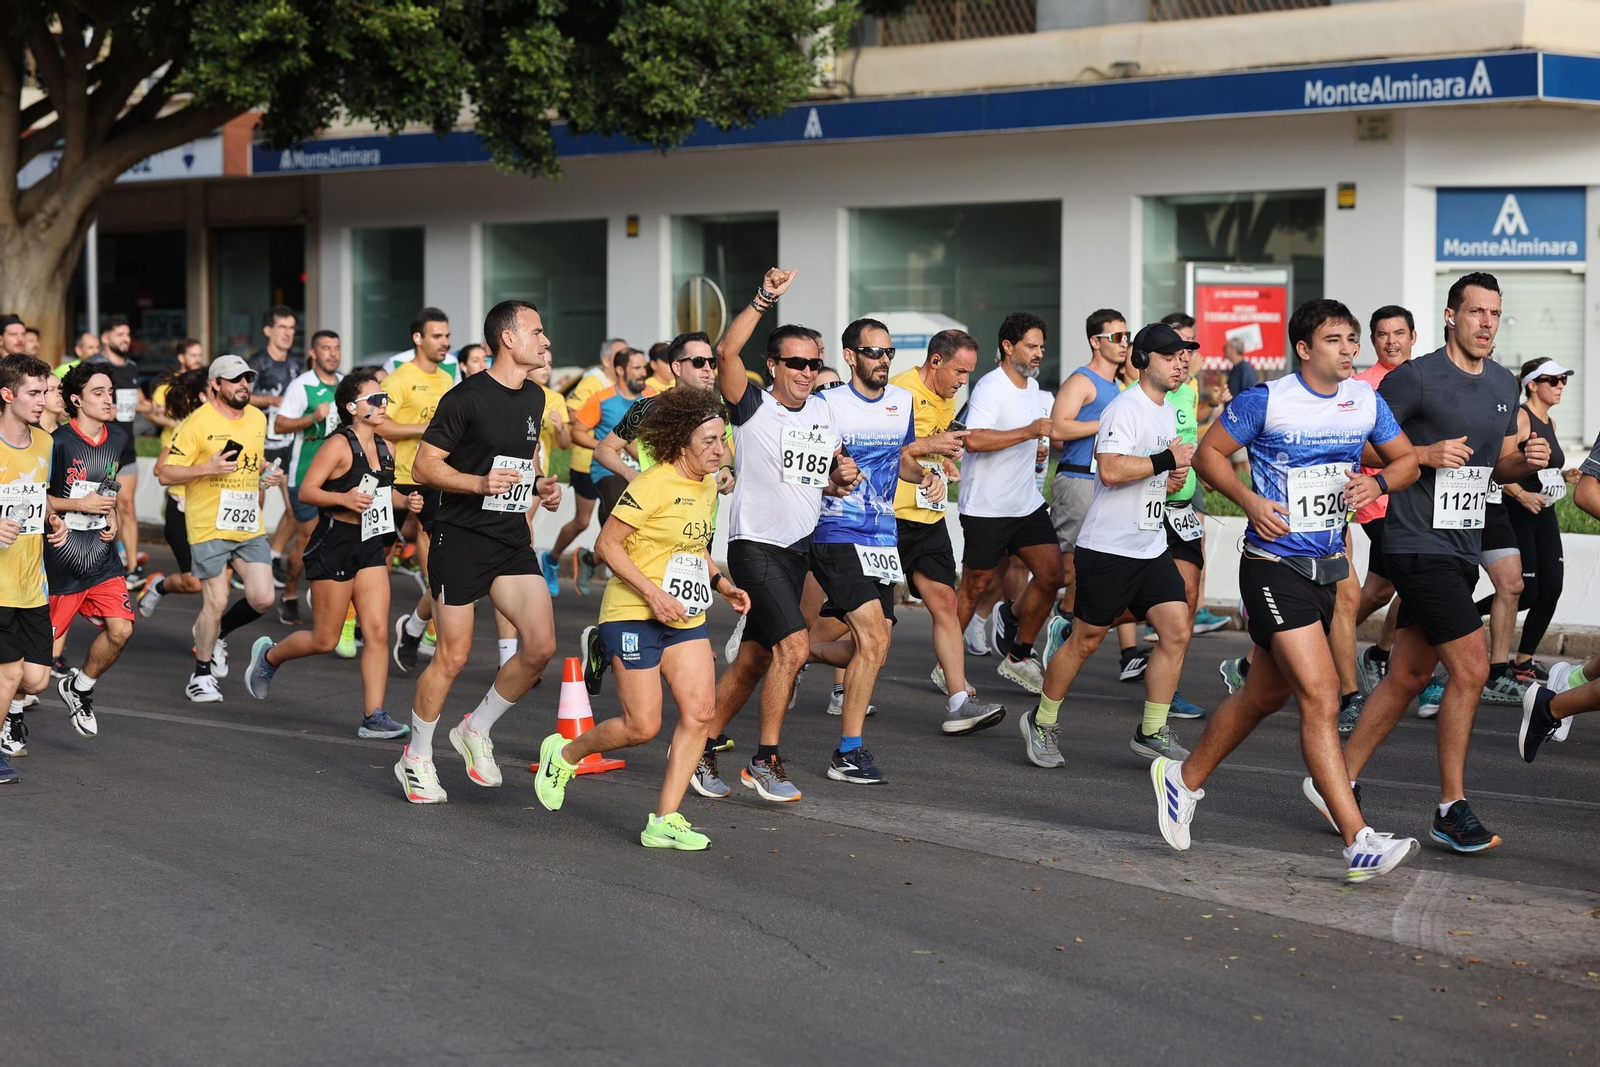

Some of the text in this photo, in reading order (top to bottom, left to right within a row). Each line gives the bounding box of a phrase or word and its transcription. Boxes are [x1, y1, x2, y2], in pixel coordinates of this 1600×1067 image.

[1304, 73, 1466, 107] MonteAlminara
[1443, 237, 1578, 257] MonteAlminara
[842, 433, 855, 446] 31
[1283, 429, 1300, 444] 31
[1304, 429, 1362, 438] TotalEnergies
[500, 460, 517, 470] 45
[783, 450, 828, 474] 8185
[67, 468, 87, 484] 24
[1298, 469, 1320, 479] 45
[1446, 470, 1465, 480] 45
[494, 483, 531, 502] 307
[1440, 491, 1486, 511] 11217
[1146, 501, 1164, 519] 10
[1297, 491, 1345, 518] 1520
[223, 508, 256, 523] 7826
[363, 506, 388, 528] 7991
[683, 522, 700, 539] 45
[676, 556, 692, 567] 45
[862, 551, 898, 571] 1306
[668, 578, 709, 604] 5890
